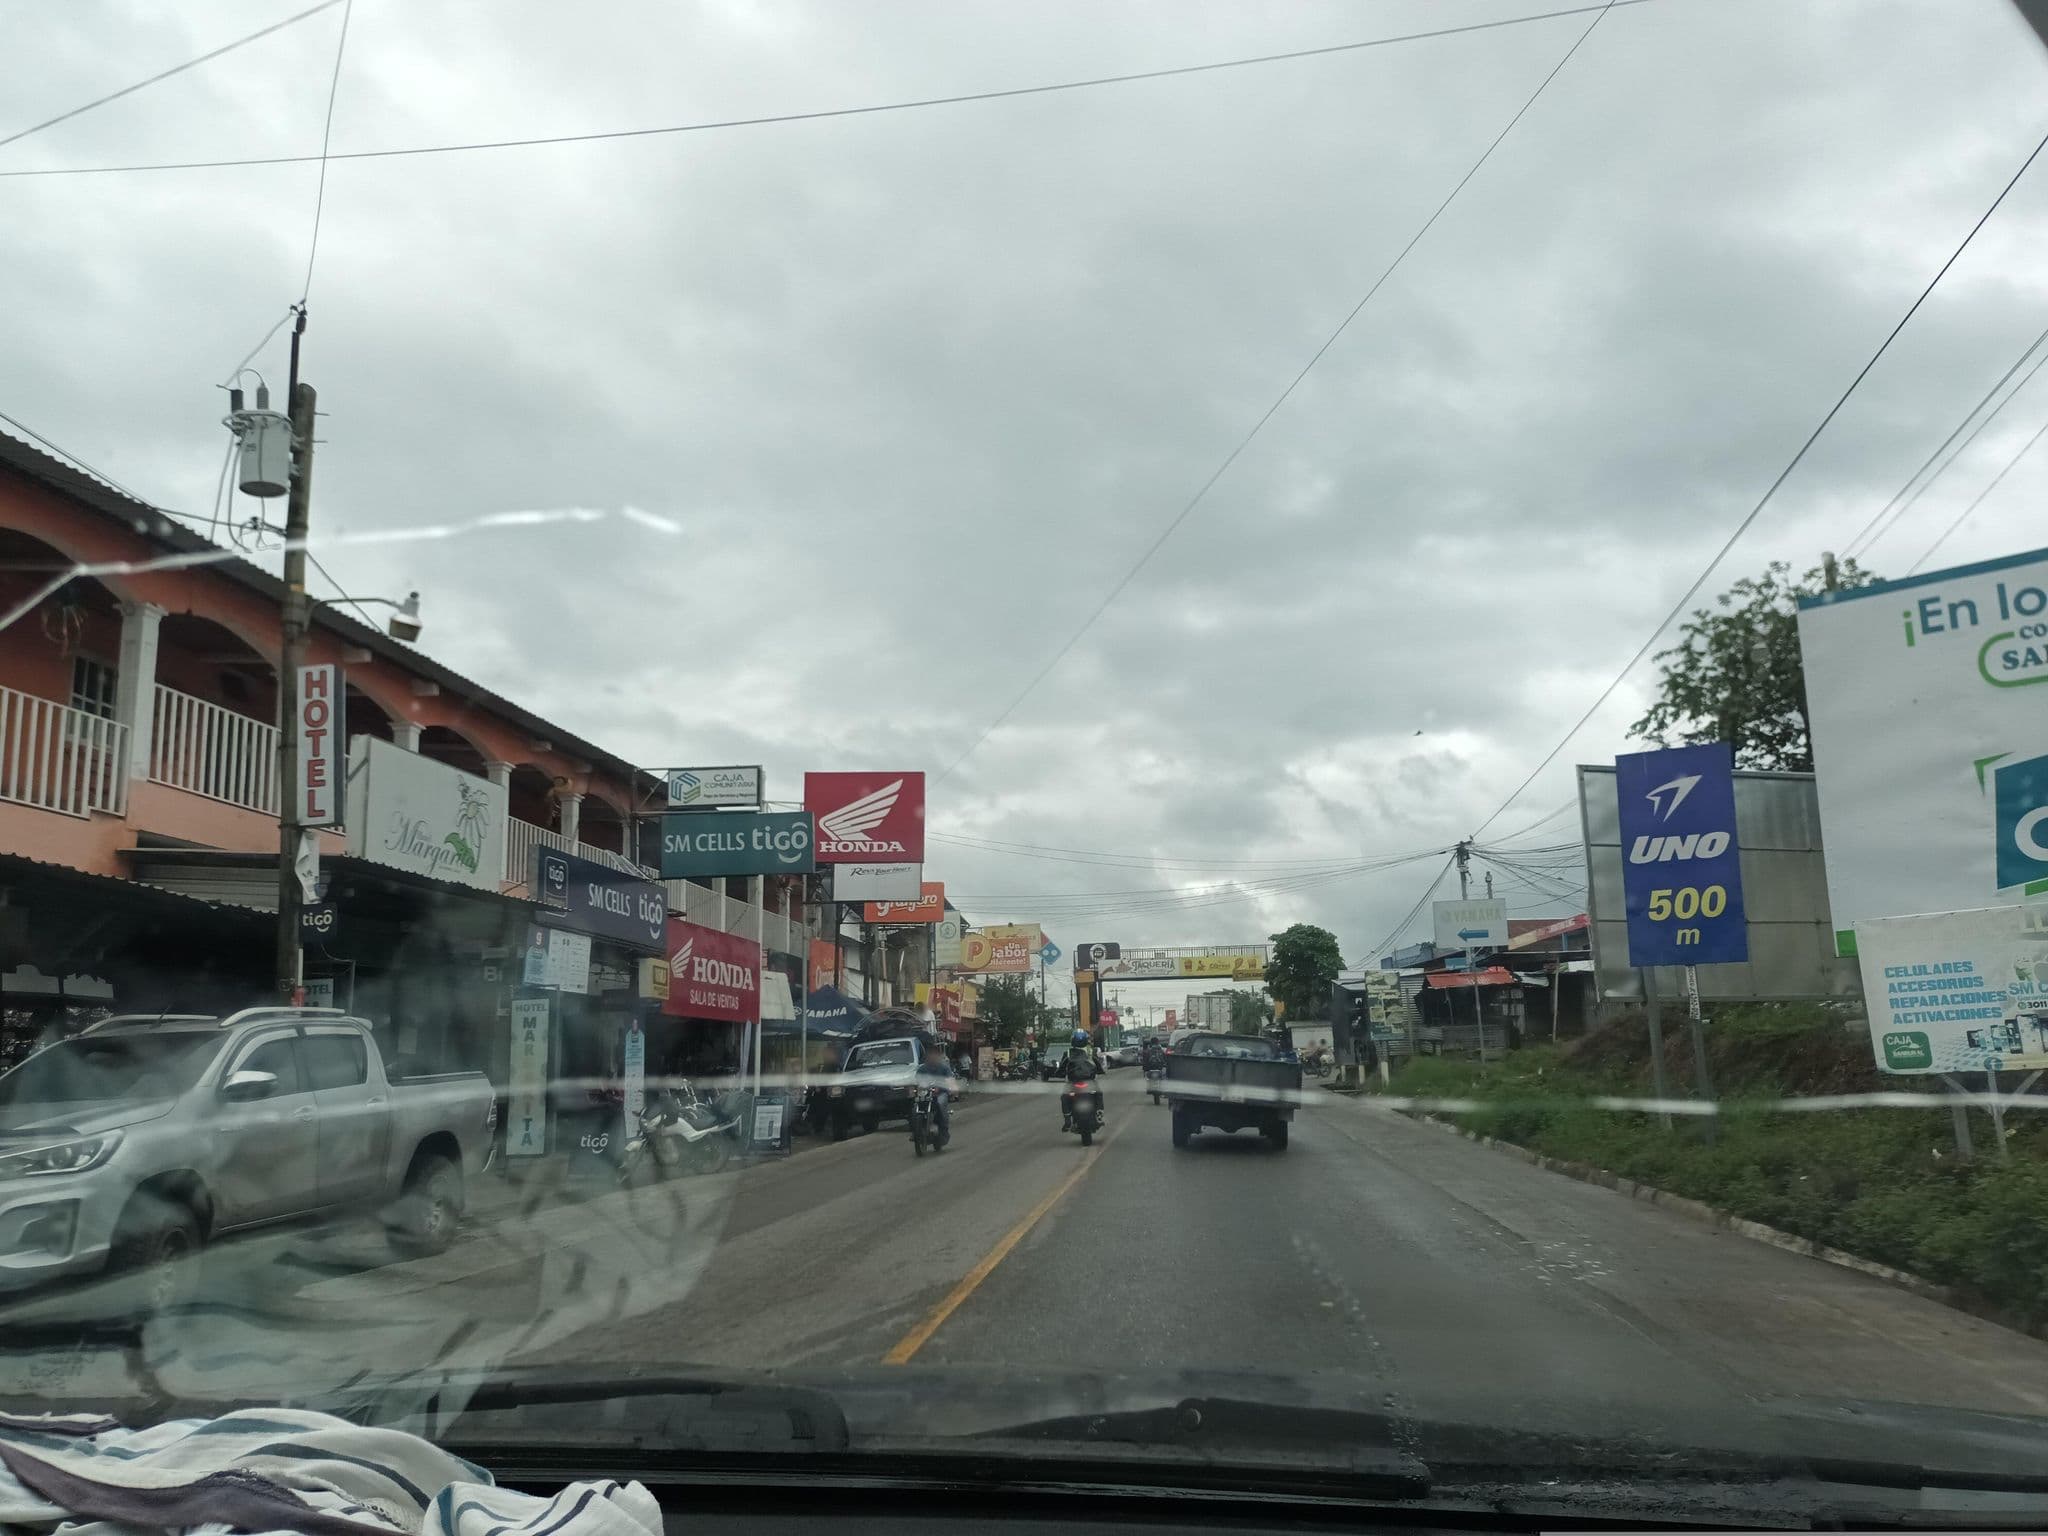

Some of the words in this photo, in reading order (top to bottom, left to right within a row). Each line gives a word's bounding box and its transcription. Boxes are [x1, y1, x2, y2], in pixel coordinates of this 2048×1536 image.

[304, 670, 328, 819] HOTEL
[713, 774, 744, 782] CAJA
[664, 834, 691, 853] SM
[695, 832, 745, 852] CELLS
[819, 840, 906, 853] HONDA
[1629, 831, 1730, 864] UNO
[588, 883, 604, 909] SM
[605, 888, 630, 916] CELLS
[1648, 885, 1727, 921] 500
[1676, 928, 1701, 945] m
[693, 956, 754, 991] HONDA
[1884, 961, 1973, 979] CELULARES
[1888, 976, 1984, 993] ACCESORIOS
[516, 1003, 547, 1012] HOTEL
[690, 989, 707, 1005] SALA
[708, 992, 716, 1007] DE
[717, 994, 739, 1010] VENTAS
[1889, 990, 2008, 1009] REPARACIONES
[1893, 1007, 2002, 1024] ACTIVACIONES
[1886, 1035, 1913, 1046] CAJA
[520, 1016, 537, 1147] MARITA
